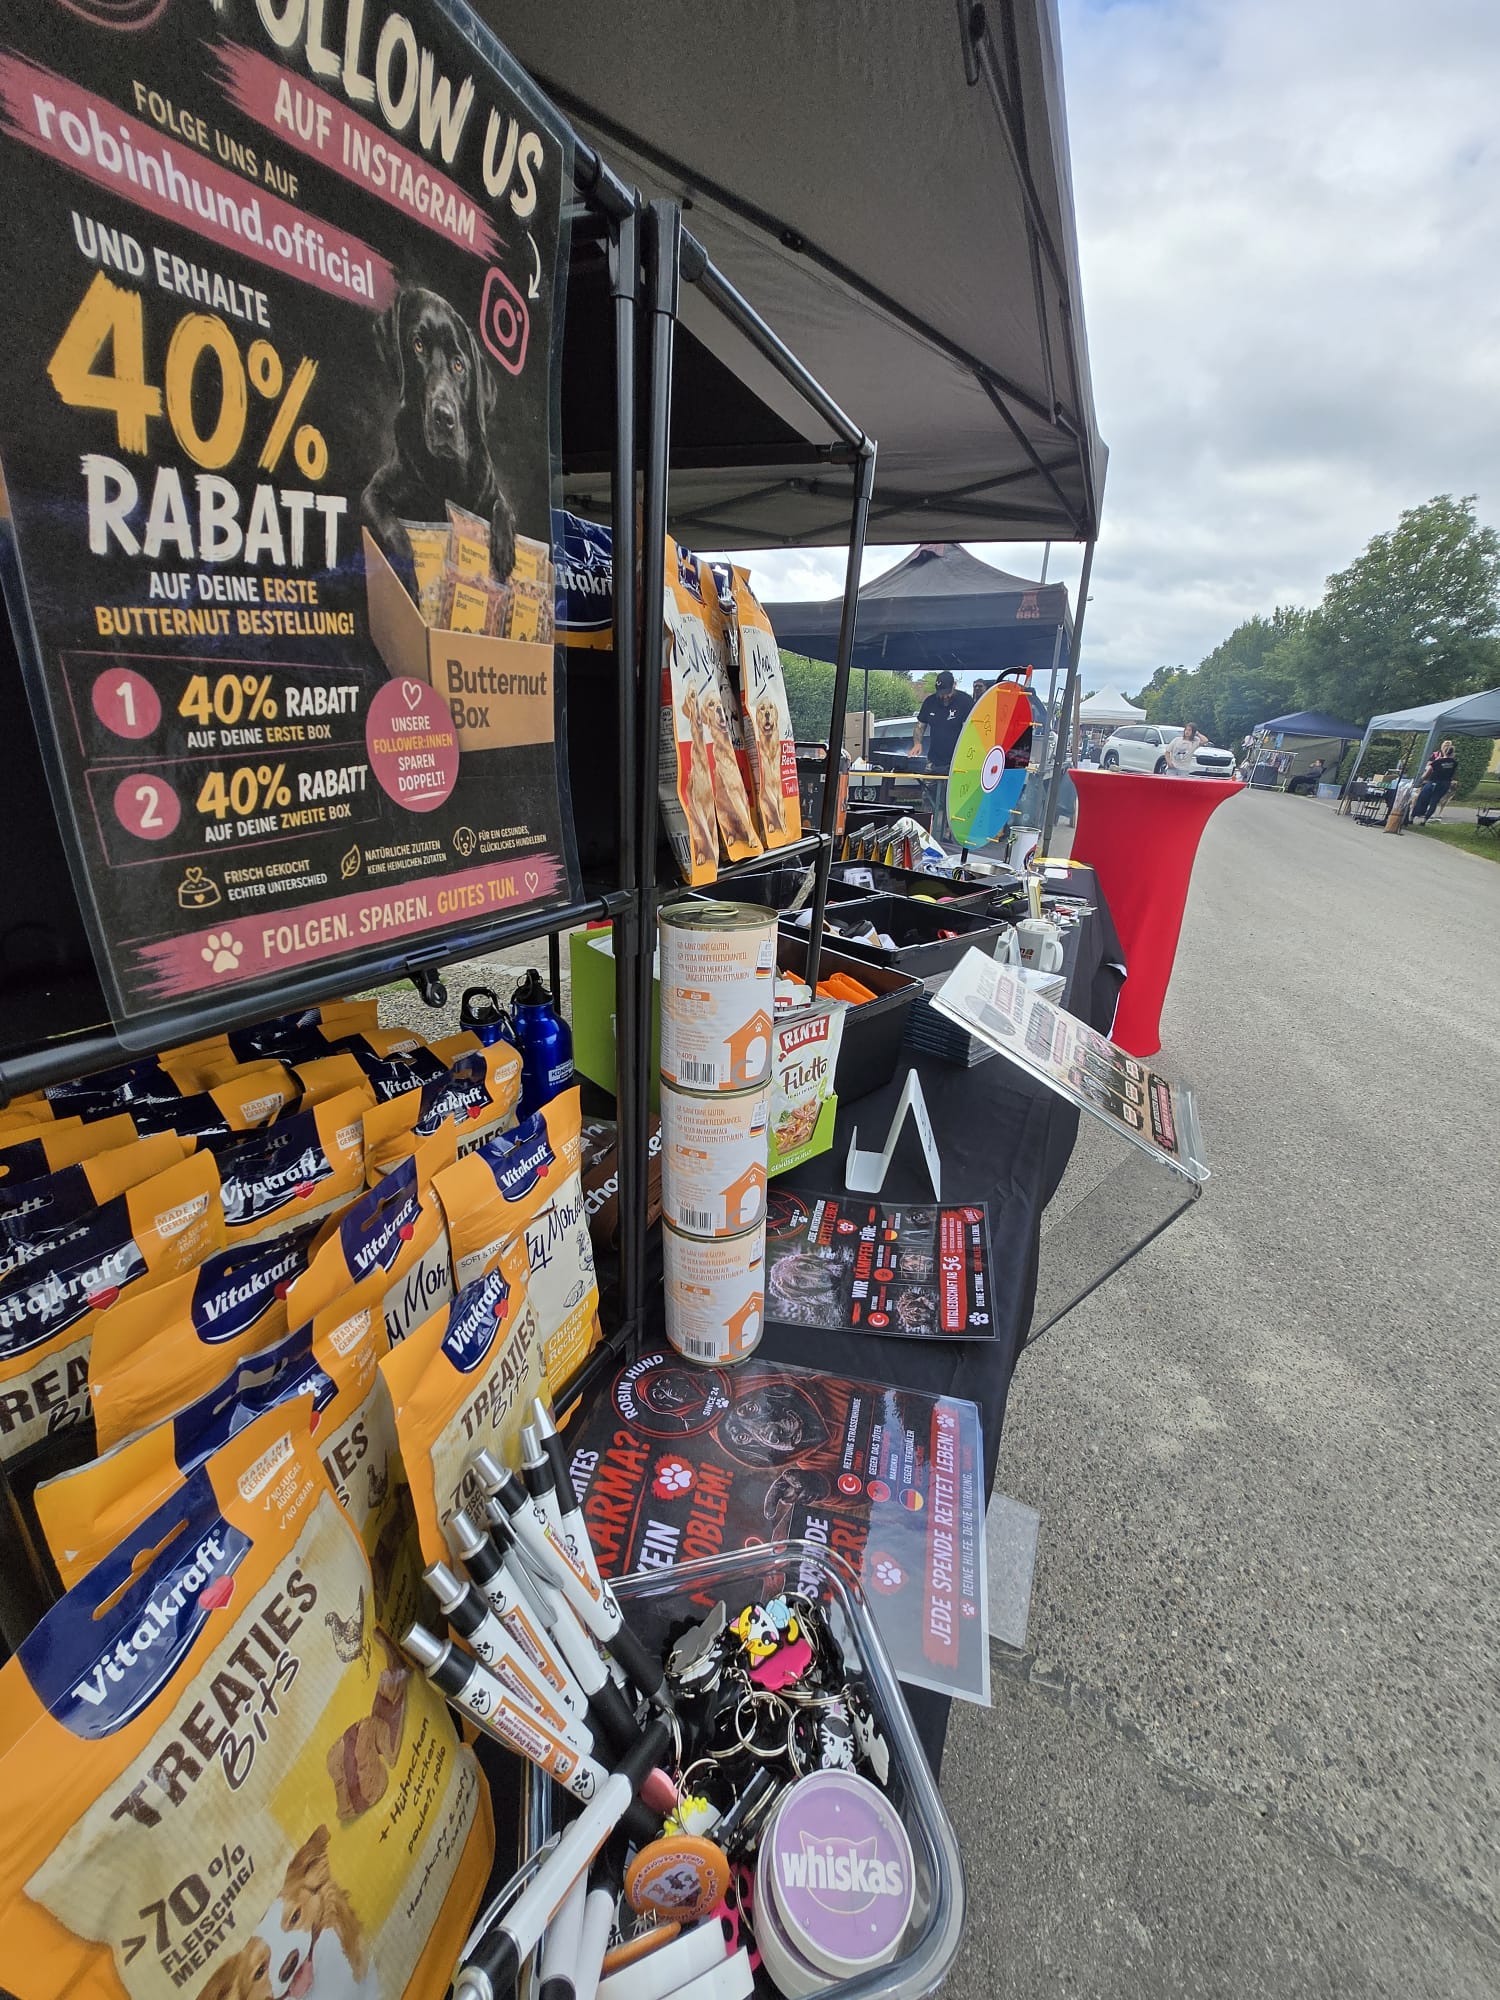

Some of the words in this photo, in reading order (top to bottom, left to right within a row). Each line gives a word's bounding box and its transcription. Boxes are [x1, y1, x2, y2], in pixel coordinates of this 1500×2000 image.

[213, 0, 475, 163] LLOW
[483, 106, 544, 217] US
[132, 80, 208, 147] FOLGE
[215, 126, 258, 178] UNS
[264, 158, 299, 198] AUF
[274, 79, 332, 151] AUF
[342, 122, 476, 244] INSTAGRAM
[33, 93, 376, 300] robinhund.official
[71, 211, 145, 277] UND
[154, 247, 271, 328] ERHALTE
[47, 270, 328, 480] 40%
[80, 453, 348, 569] RABATT
[149, 573, 192, 601] AUF
[200, 575, 260, 602] DEINE
[263, 578, 319, 604] ERSTE
[556, 563, 612, 597] itakr
[95, 607, 232, 636] BUTTERNUT
[238, 608, 355, 636] BESTELLUNG!
[447, 659, 547, 695] Butternut
[116, 681, 136, 726] 1
[178, 674, 278, 725] 40%
[285, 686, 359, 718] RABATT
[450, 698, 490, 729] Box
[187, 731, 217, 749] AUF
[221, 728, 264, 747] DEINE
[265, 725, 305, 743] ERSTE
[307, 724, 332, 740] BOX
[373, 733, 453, 754] FOLLOWER:INNEN
[391, 716, 431, 732] UNSERE
[398, 754, 435, 771] SPAREN
[398, 771, 446, 792] DOPPELT!
[135, 785, 164, 828] 2
[196, 763, 291, 820] 40%
[298, 765, 368, 802] RABATT
[204, 825, 233, 843] AUF
[237, 815, 279, 838] DEINE
[281, 807, 327, 829] ZWEITE
[329, 803, 352, 820] BOX
[478, 828, 490, 840] FÜR
[491, 828, 500, 838] EIN
[500, 825, 530, 838] GESUNDES,
[365, 844, 410, 861] NATÜRLICHE
[411, 840, 441, 854] ZUTATEN
[367, 860, 386, 874] KEINE
[387, 856, 423, 871] HEIMLICHEN
[423, 852, 447, 865] ZUTATEN
[480, 838, 516, 854] GLÜCKLICHES
[515, 834, 547, 848] HUNDELEBEN
[224, 867, 263, 885] FRISCH
[266, 859, 310, 878] GEKOCHT
[228, 884, 266, 901] ECHTER
[268, 873, 328, 895] UNTERSCHIED
[262, 913, 354, 958] FOLGEN.
[359, 895, 433, 934] SPAREN.
[437, 887, 485, 915] GUTES
[487, 875, 519, 904] TUN.
[782, 1018, 826, 1050] RINTI
[779, 1056, 828, 1095] Filetto
[219, 1152, 318, 1207] Vitakraft
[501, 1141, 547, 1188] Vitakraft
[157, 1205, 189, 1227] MADE
[353, 1193, 415, 1271] Vitakraft
[859, 1224, 877, 1242] FÜR:
[460, 1255, 481, 1268] SOFT
[853, 1241, 875, 1280] KÄMPFEN
[942, 1255, 962, 1271] 5€
[950, 1271, 958, 1280] AB
[0, 1252, 126, 1329] itakraft
[201, 1250, 300, 1322] Vitakraft
[851, 1280, 869, 1298] WIR
[946, 1279, 959, 1328] MITGLIEDSCHAFT
[447, 1268, 506, 1355] Vitakraft
[549, 1300, 589, 1351] Chicken
[333, 1323, 353, 1345] MADE
[460, 1307, 536, 1441] TREATIES
[491, 1357, 530, 1430] Bits
[617, 1379, 635, 1421] ROBIN
[627, 1353, 664, 1382] HUND
[702, 1397, 717, 1417] SINCE
[712, 1386, 721, 1398] 24
[847, 1397, 861, 1443] STRASSENHUNDE
[872, 1424, 882, 1441] TÖTEN
[904, 1429, 915, 1462] TIERQUÄLER
[239, 1455, 269, 1488] MADE
[843, 1442, 855, 1469] RETTUNG
[868, 1456, 878, 1476] GEGEN
[937, 1426, 956, 1480] LEBEN!
[271, 1487, 282, 1500] NO
[282, 1461, 302, 1489] SUGAR
[903, 1463, 912, 1485] GEGEN
[963, 1470, 975, 1511] WIRKUNG.
[276, 1482, 298, 1510] ADDED
[285, 1506, 297, 1521] NO
[295, 1479, 315, 1508] GRAIN
[937, 1485, 956, 1531] RETTET
[964, 1512, 975, 1537] DEINE
[932, 1538, 954, 1595] SPENDE
[963, 1538, 976, 1566] HILFE.
[961, 1568, 976, 1597] DEINE
[72, 1536, 227, 1708] Vitakraft
[929, 1603, 952, 1645] JEDE
[111, 1568, 318, 1829] TREATIES
[220, 1650, 301, 1792] Bits
[413, 1738, 437, 1807] chicken
[408, 1786, 436, 1855] poulet,
[433, 1745, 446, 1785] pollo
[781, 1844, 903, 1897] whiskas
[160, 1855, 255, 1975] FLEISCHIG/
[170, 1909, 237, 1990] MEATY
